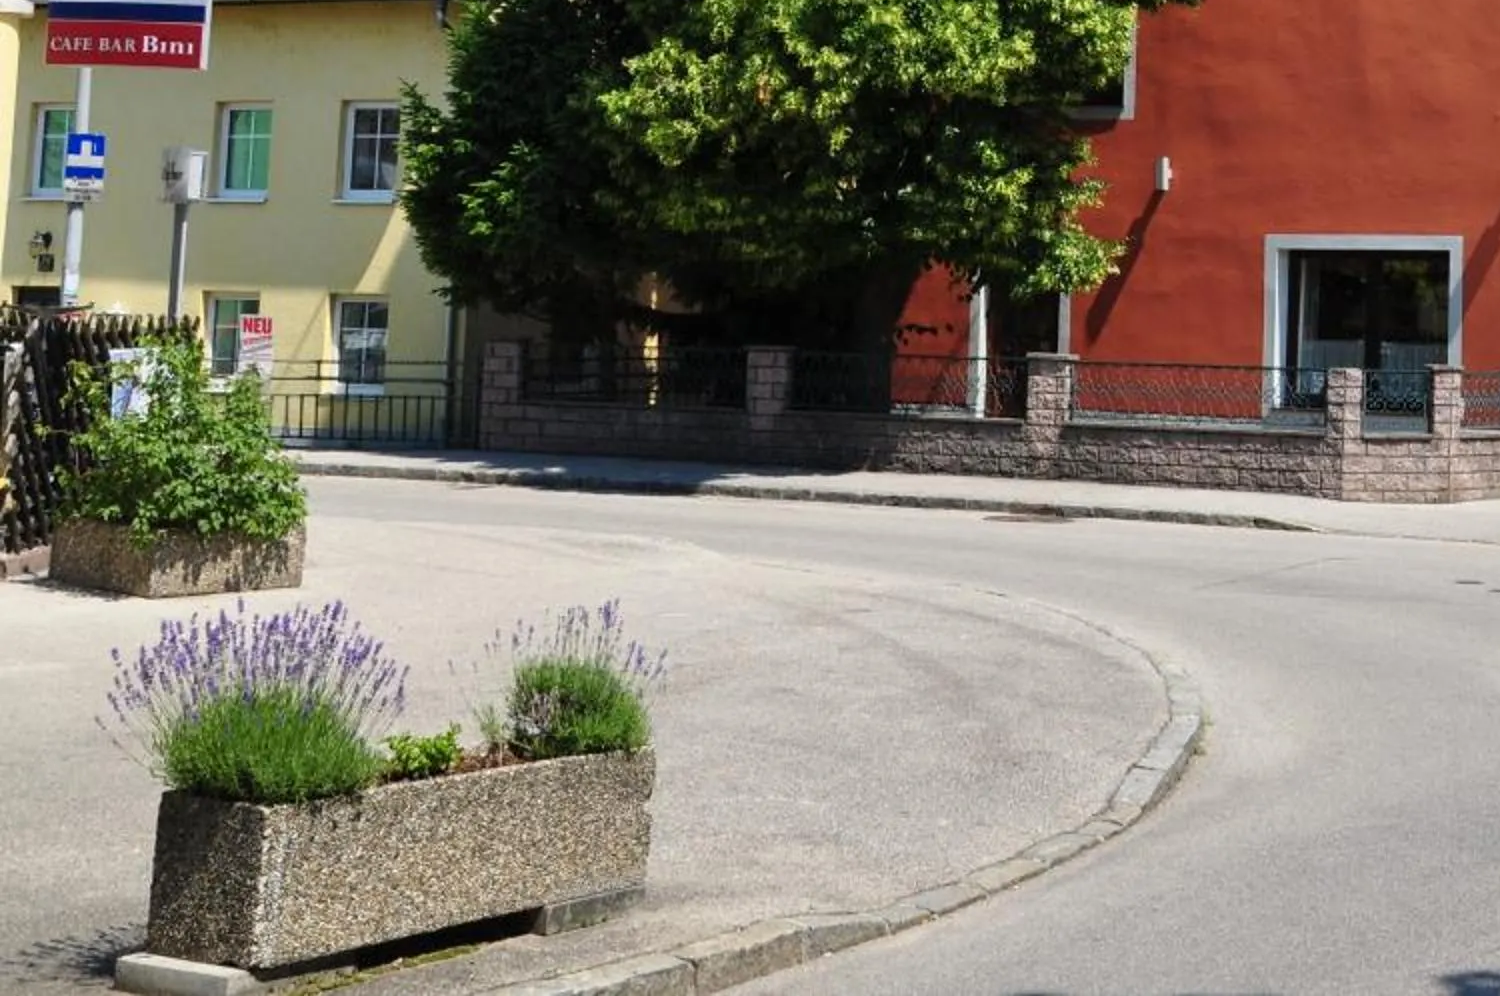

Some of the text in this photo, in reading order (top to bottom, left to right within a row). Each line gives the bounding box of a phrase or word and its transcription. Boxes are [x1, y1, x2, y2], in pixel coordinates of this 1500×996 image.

[50, 36, 92, 51] CAFE
[99, 37, 137, 53] BAR
[243, 317, 273, 333] NEU
